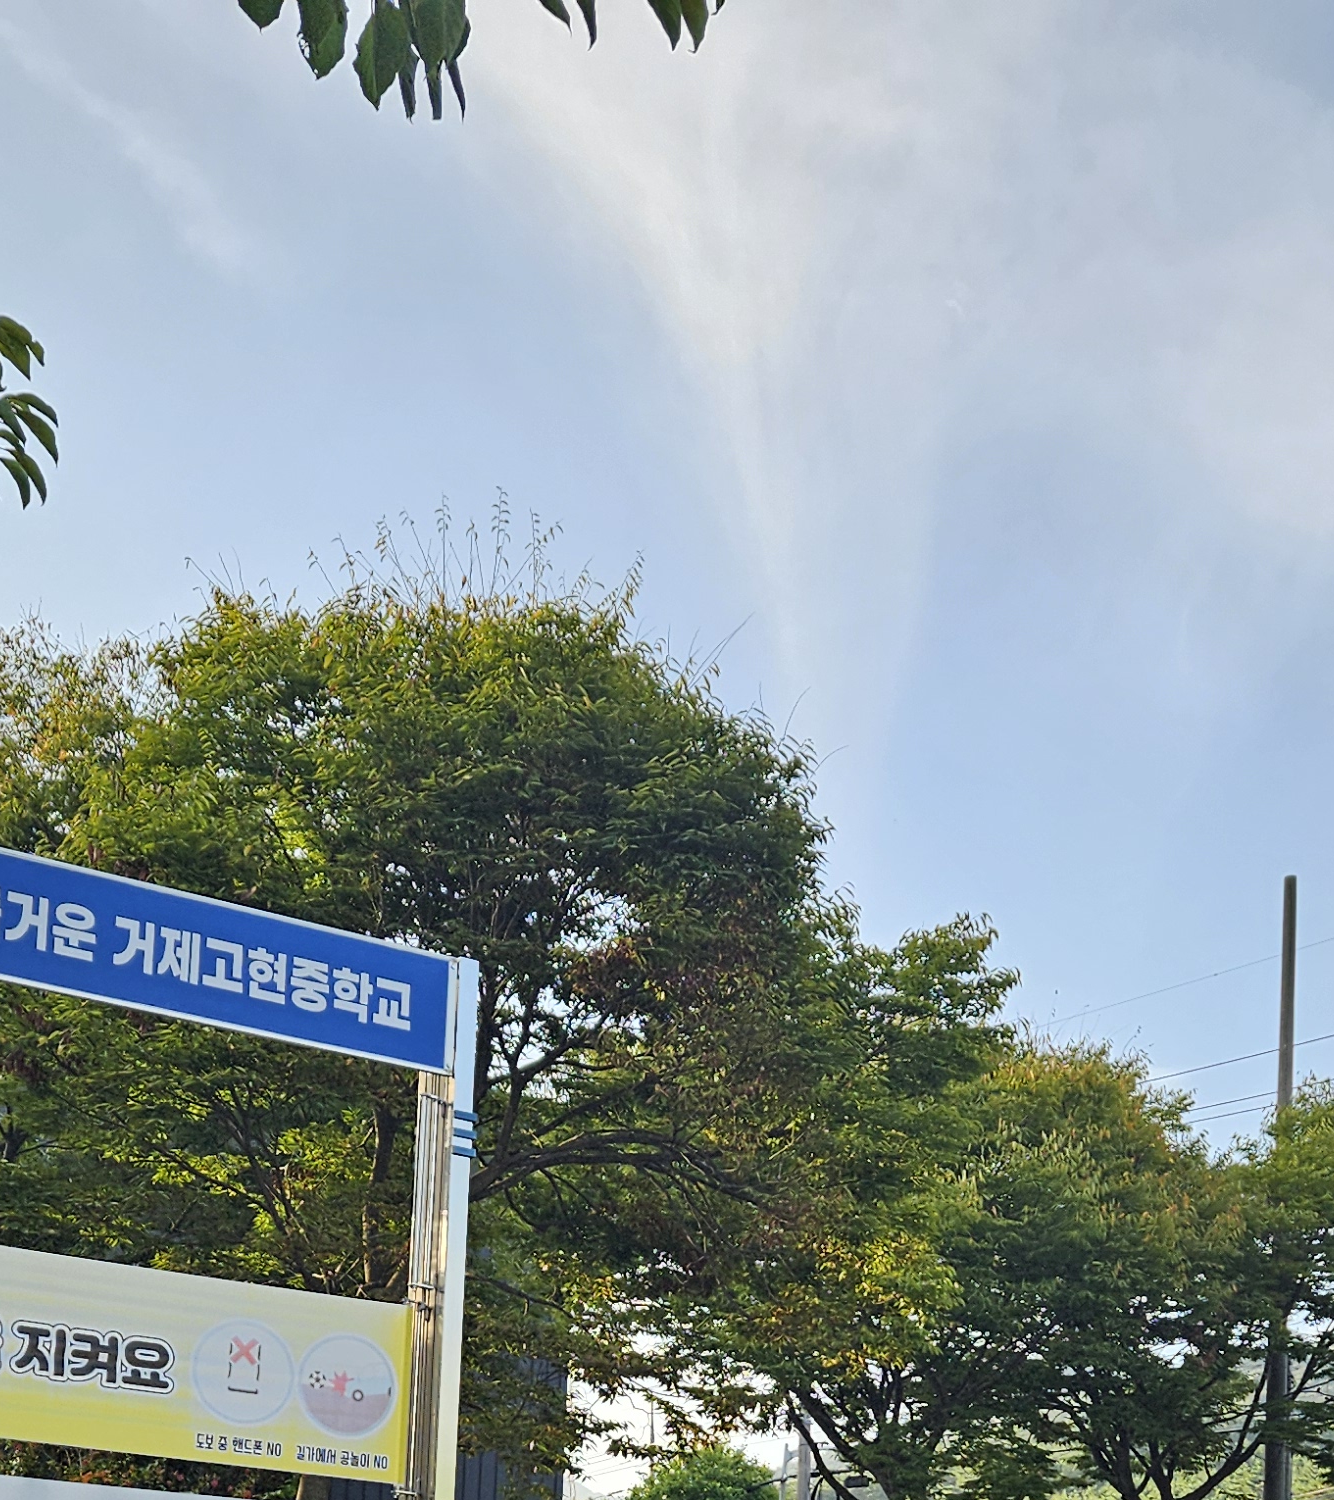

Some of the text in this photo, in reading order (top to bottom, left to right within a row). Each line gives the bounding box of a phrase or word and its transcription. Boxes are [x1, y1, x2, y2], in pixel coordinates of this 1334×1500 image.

[113, 915, 411, 1031] 거제고현중학교
[14, 1322, 178, 1393] 지켜요
[195, 1434, 215, 1451] 도보
[217, 1435, 228, 1452] 중
[267, 1442, 282, 1458] NO
[295, 1446, 389, 1470] 길가에서 공놀이 NO
